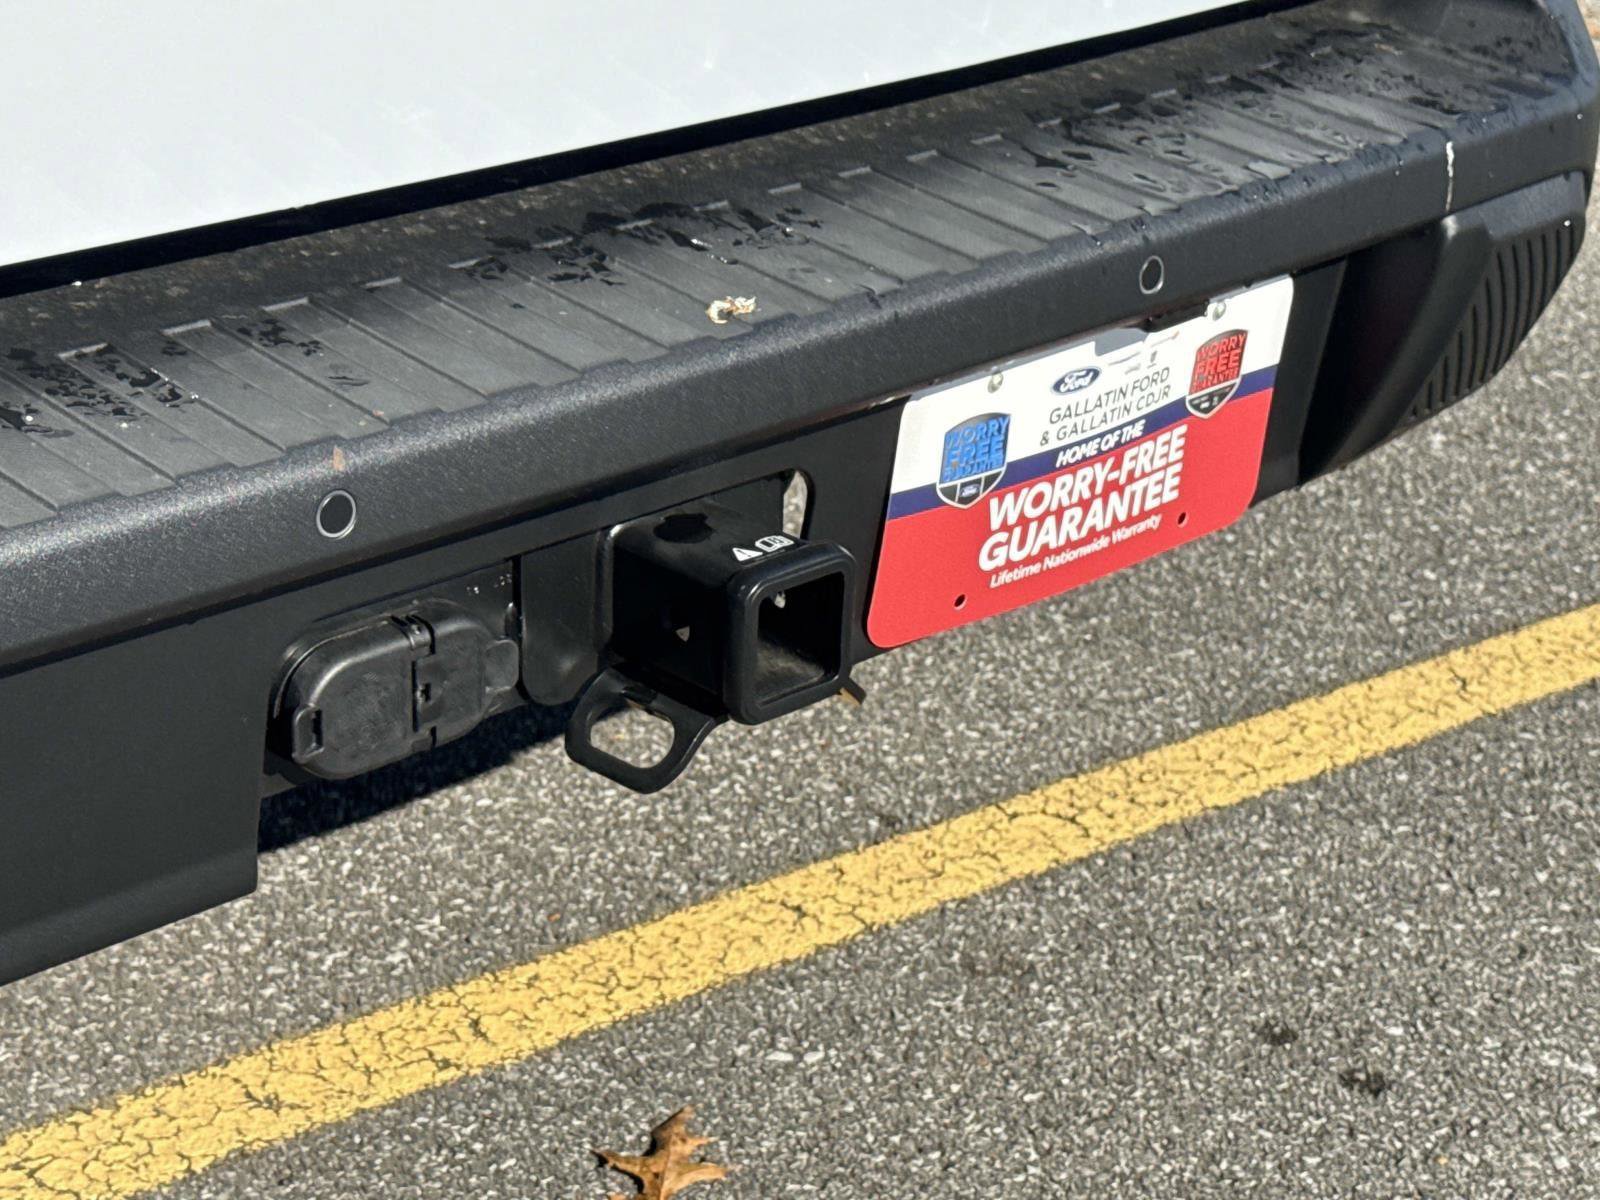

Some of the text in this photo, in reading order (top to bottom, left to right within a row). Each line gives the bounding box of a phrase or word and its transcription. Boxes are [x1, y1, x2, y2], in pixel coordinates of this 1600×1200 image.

[1196, 348, 1241, 378] FREE
[1197, 333, 1245, 362] WORRY
[1049, 366, 1170, 424] GALLATIN FORD
[1056, 367, 1097, 394] Ford
[945, 416, 1009, 450] WORRY
[1040, 430, 1050, 446] &
[1056, 401, 1132, 441] GALLATIN
[1136, 384, 1171, 411] CDJR
[944, 434, 1005, 470] FREE
[1055, 419, 1146, 467] HOME OF THE
[989, 424, 1188, 531] WORRY-FREE
[978, 462, 1183, 572] GUARANTEE
[989, 513, 1162, 588] Lifetime Nationwide Warranty
